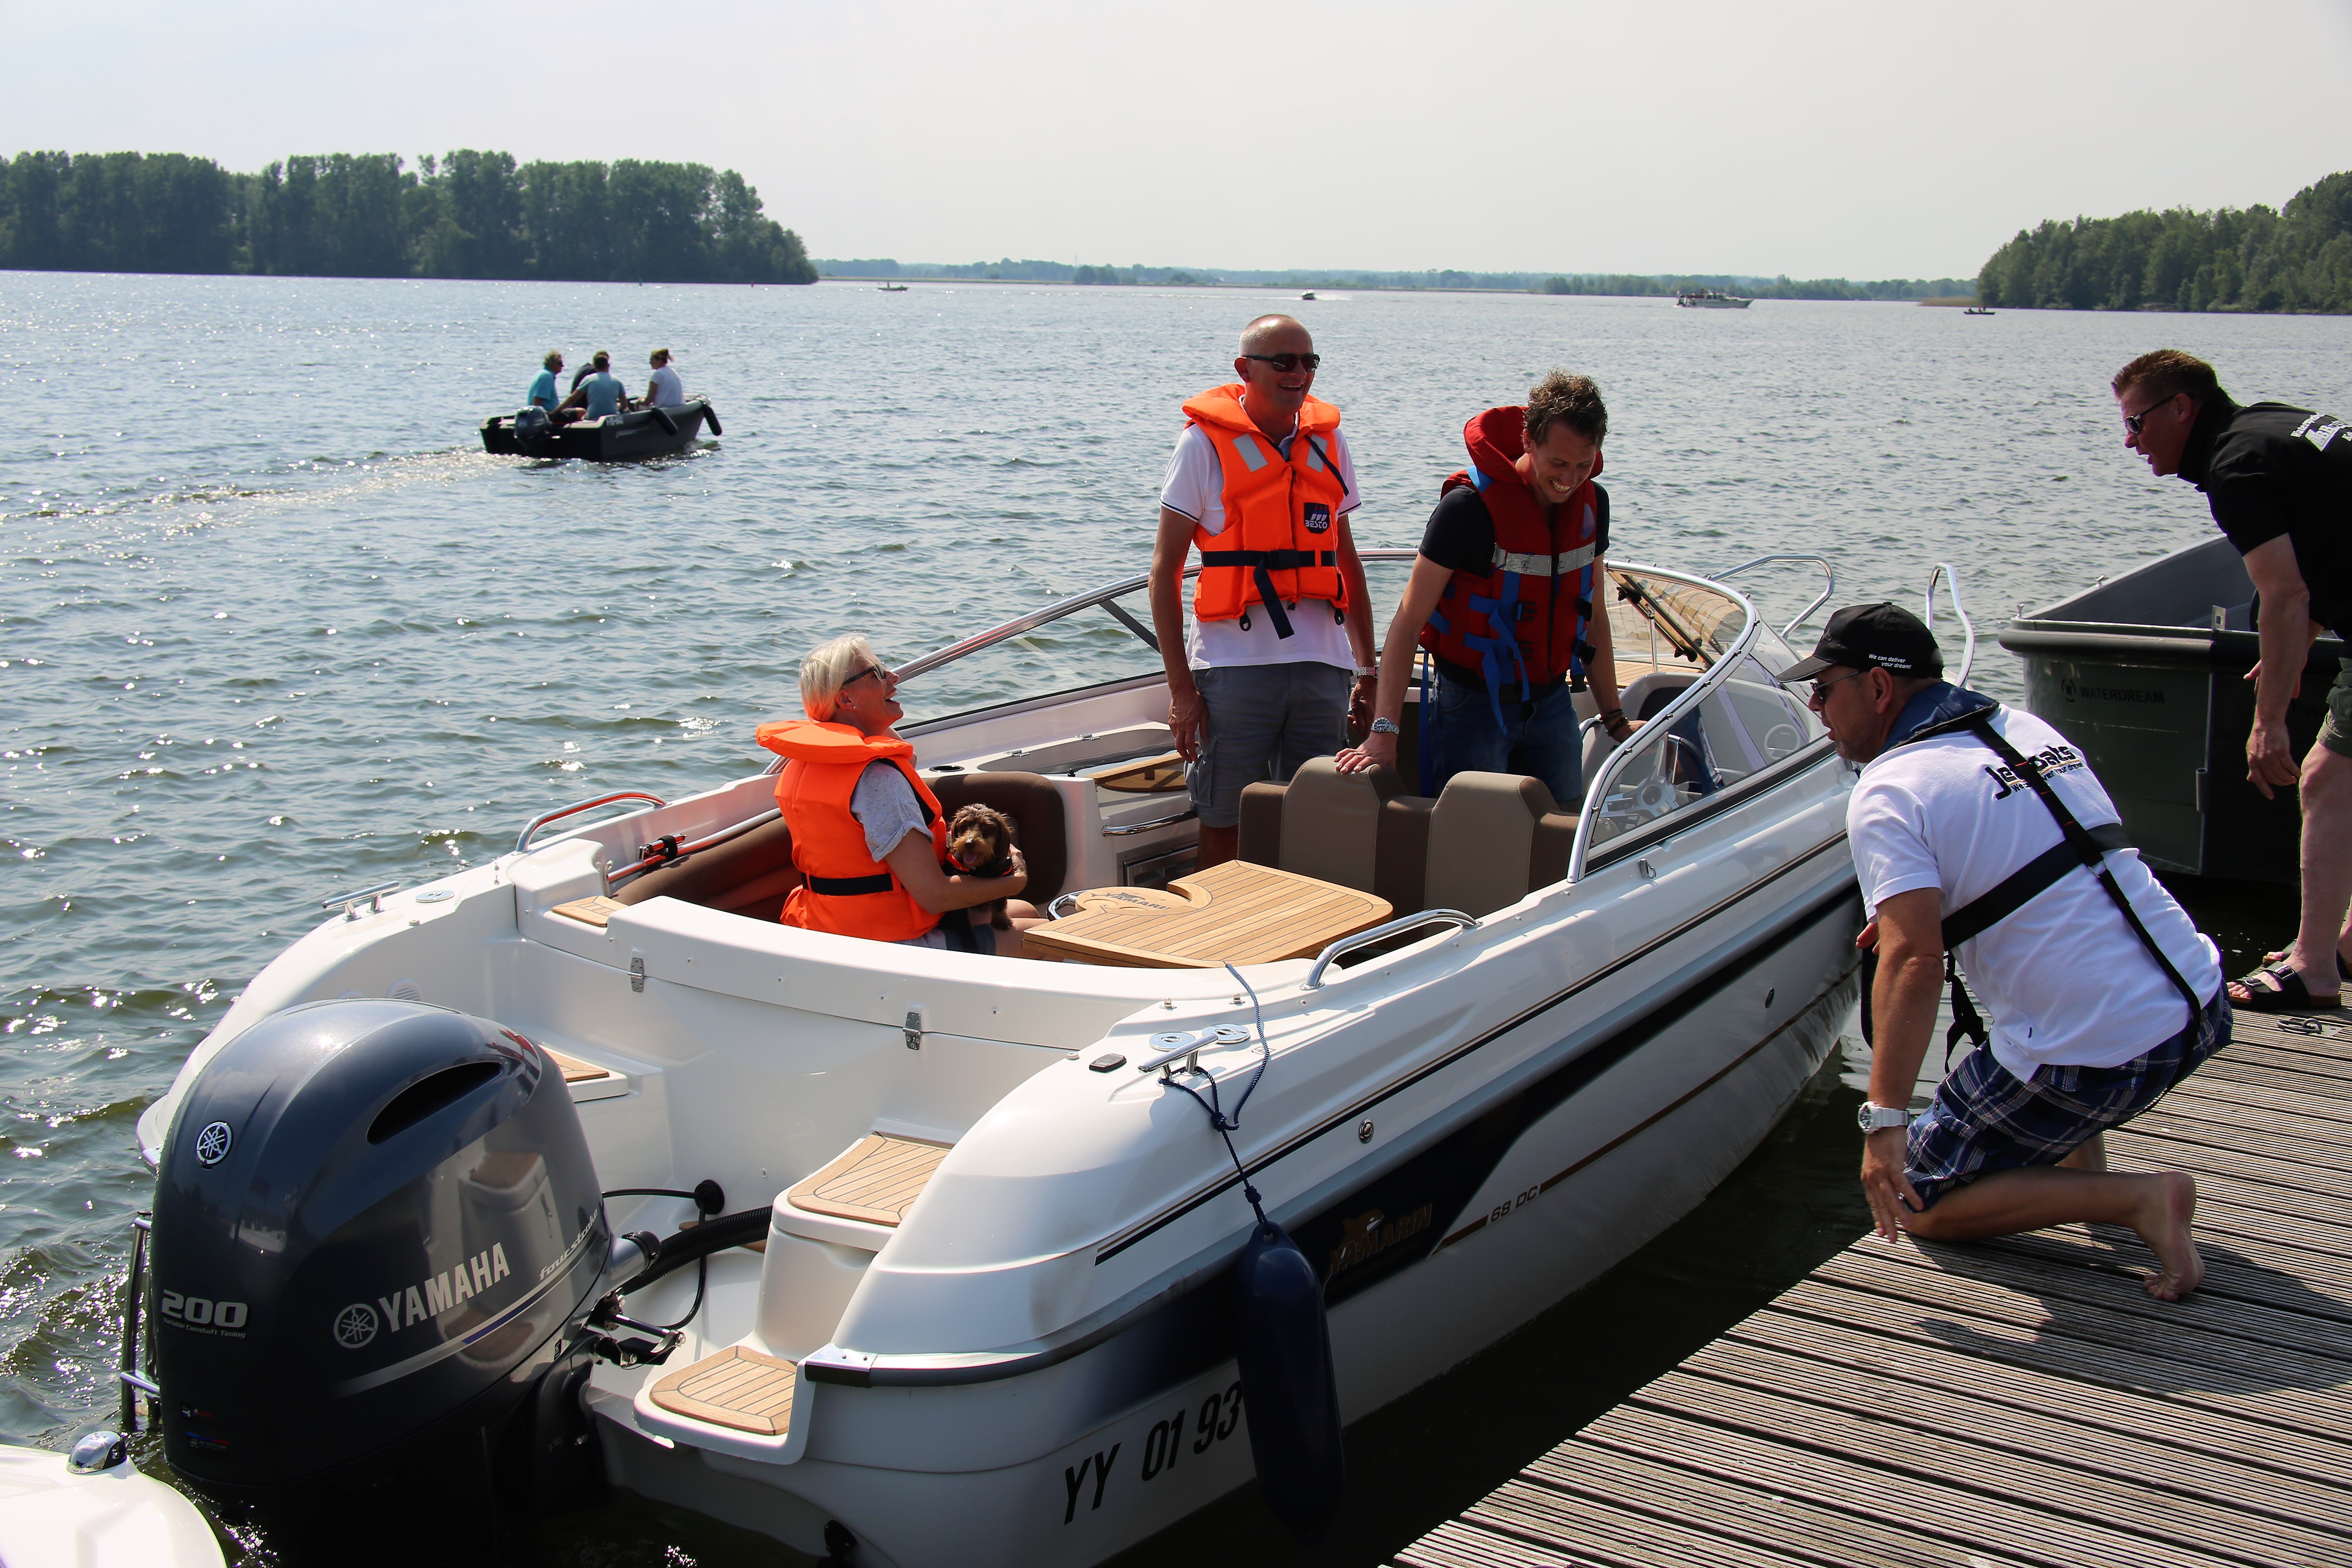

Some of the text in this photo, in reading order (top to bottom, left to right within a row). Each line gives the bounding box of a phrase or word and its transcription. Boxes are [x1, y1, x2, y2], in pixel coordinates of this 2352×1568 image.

[1305, 520, 1327, 529] BESTO
[2080, 686, 2165, 704] WATERDREAM
[1491, 1185, 1538, 1223] 68 DC
[1329, 1203, 1432, 1276] YAMARIN
[378, 1242, 510, 1332] YAMAHA
[162, 1289, 248, 1328] 200
[186, 1324, 218, 1335] Camshaft
[220, 1330, 246, 1339] Timing
[1064, 1380, 1243, 1526] YY 01 93
